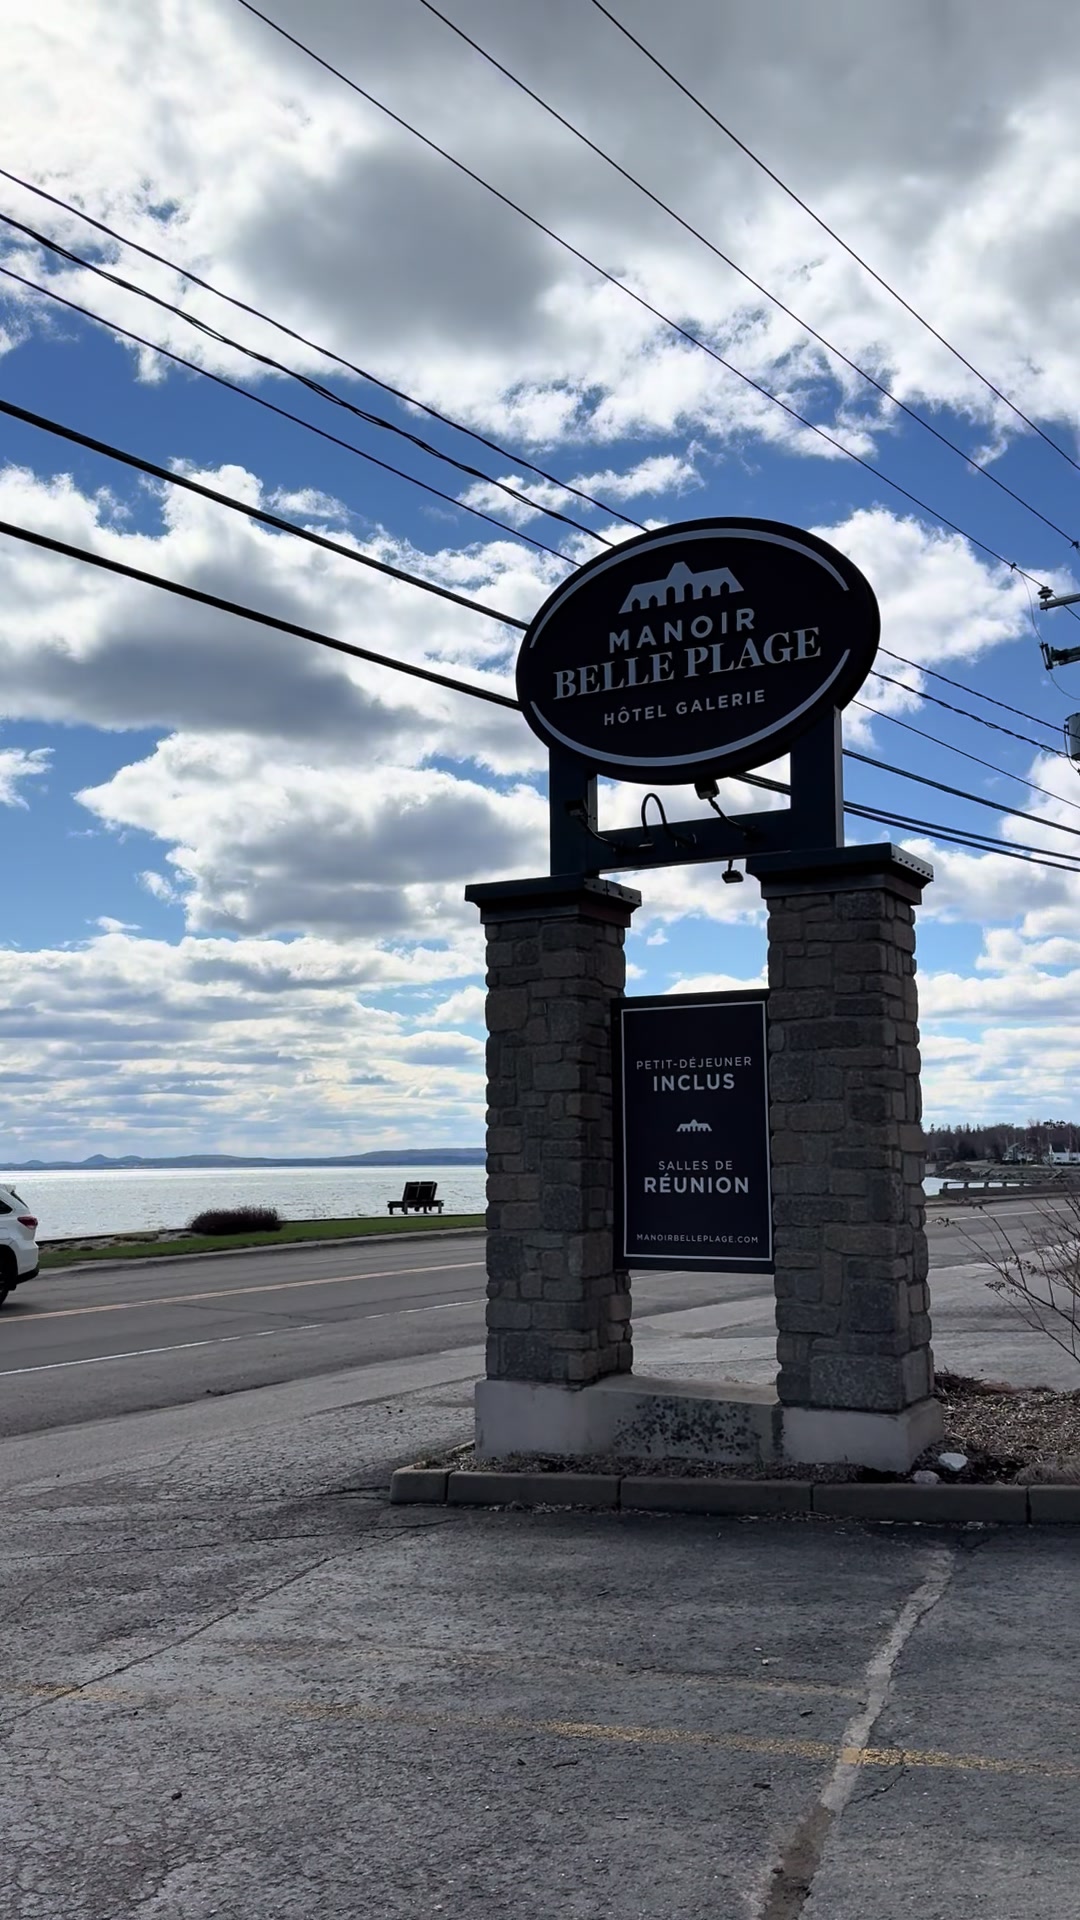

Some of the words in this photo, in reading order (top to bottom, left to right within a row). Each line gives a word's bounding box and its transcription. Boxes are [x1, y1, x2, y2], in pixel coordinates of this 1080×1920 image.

[608, 608, 755, 653] MANOIR
[553, 651, 675, 700] BELLE
[684, 627, 822, 678] PLAGE
[603, 706, 667, 726] HÔTEL
[676, 689, 766, 715] GALERIE
[636, 1056, 752, 1070] PETIT-DÉJEUNER
[653, 1073, 735, 1092] INCLUS
[658, 1160, 709, 1171] SALLES
[715, 1160, 733, 1170] DE
[644, 1173, 749, 1194] RÉUNION
[636, 1233, 759, 1244] MANOIRBELLEPLAGE.COM
